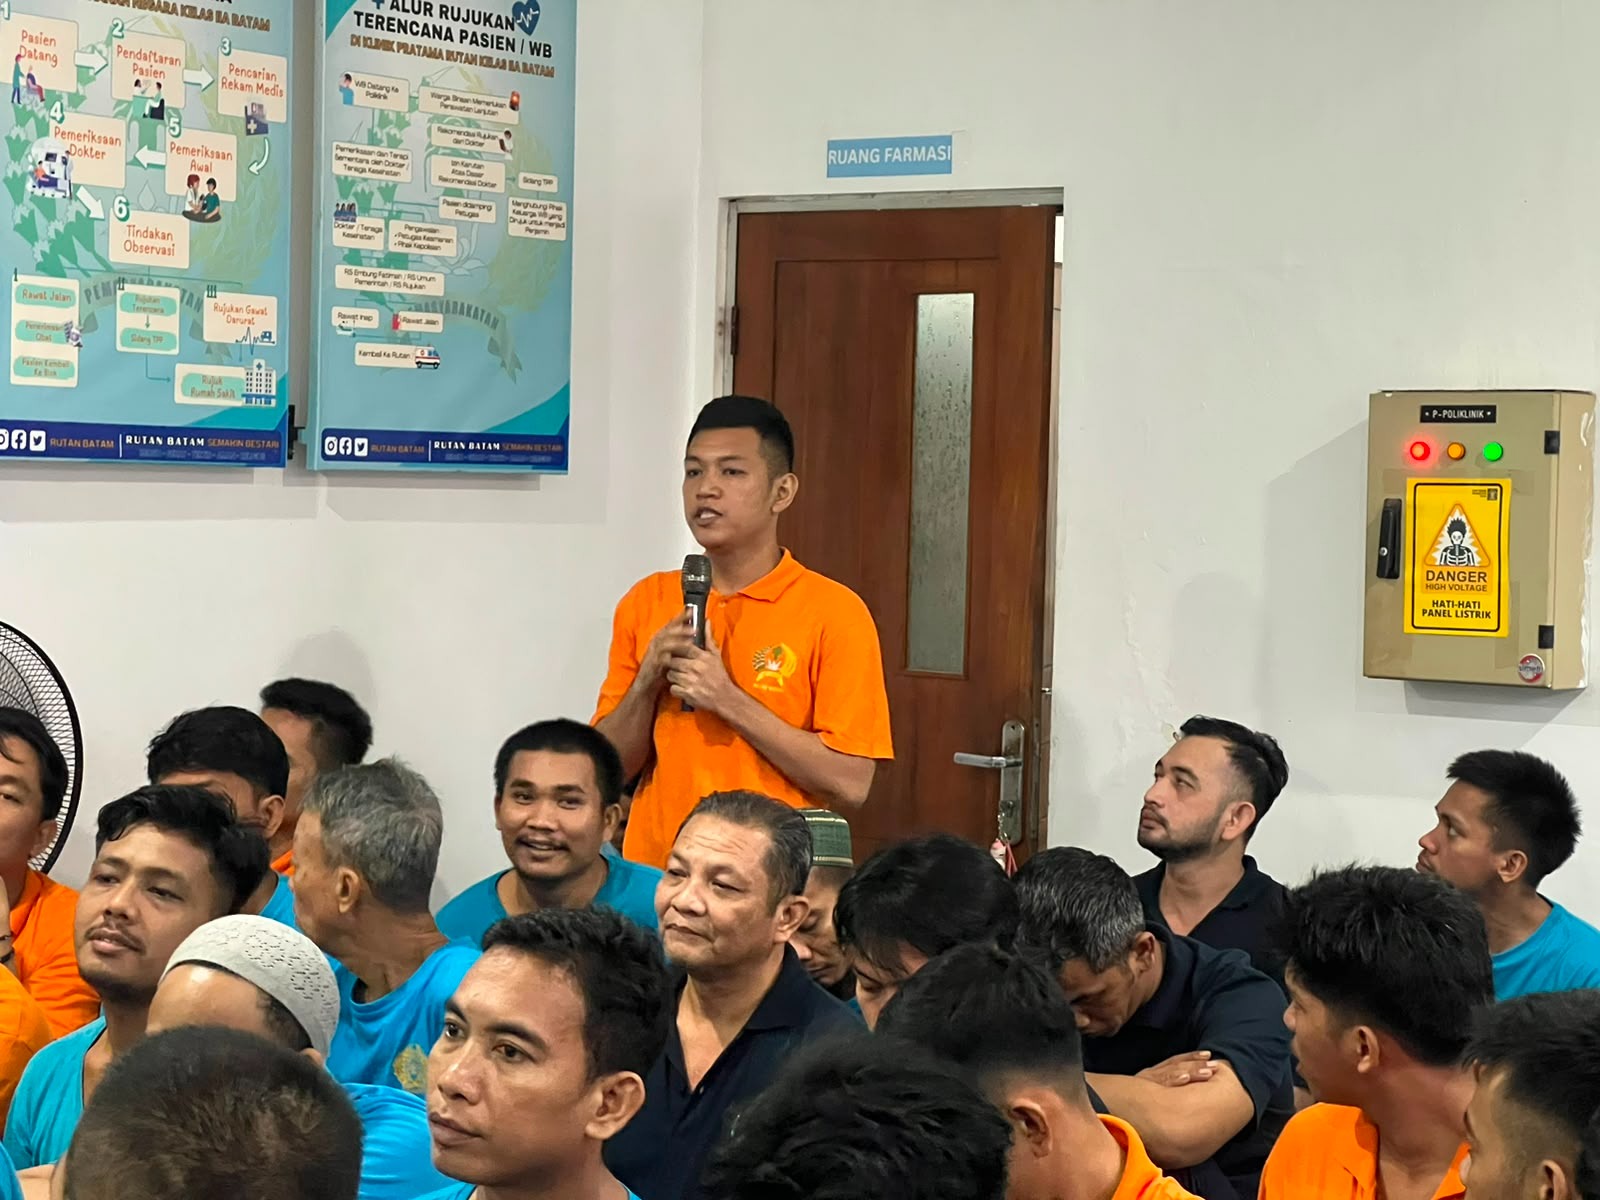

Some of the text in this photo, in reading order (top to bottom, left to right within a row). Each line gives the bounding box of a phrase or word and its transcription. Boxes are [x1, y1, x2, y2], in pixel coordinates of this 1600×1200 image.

[1, 1, 10, 20] 1
[180, 5, 213, 22] KELAS
[231, 14, 270, 32] BATAM
[390, 0, 515, 31] ALUR RUJUKAN
[111, 18, 124, 38] 2
[353, 10, 454, 42] TERENCANA
[459, 29, 515, 52] PASIEN
[529, 41, 552, 58] WB
[21, 29, 56, 47] Pasien
[221, 38, 231, 55] 3
[19, 45, 58, 68] Datang
[116, 44, 181, 67] Pendaftaran
[350, 34, 361, 47] DI
[363, 36, 395, 53] KLINIK
[396, 41, 444, 60] PRATAMA
[446, 49, 478, 66] RUTAN
[479, 55, 507, 70] KELAS
[521, 62, 555, 78] BATAM
[132, 62, 166, 80] Pasien
[228, 63, 277, 83] Pencarian
[221, 76, 284, 98] Rekam Medis
[50, 101, 64, 122] 4
[169, 117, 181, 137] 5
[54, 126, 122, 147] Pemeriksaan
[69, 144, 106, 160] Dokter
[169, 141, 233, 161] Pemeriksaan
[828, 145, 951, 165] RUANG FARMASI
[190, 159, 213, 173] Awal
[114, 196, 129, 220] 6
[126, 224, 173, 242] Tindakan
[123, 240, 176, 257] Observasi
[22, 288, 71, 302] Rawat Jalan
[213, 302, 268, 316] Rujukan Gawat
[226, 314, 255, 326] Darurat
[190, 387, 215, 398] Rumah
[1432, 409, 1484, 419] P-POLIKLINIK
[50, 437, 115, 449] RUTAN BATAM
[125, 435, 164, 446] RUTAN
[166, 436, 205, 447] BATAM
[207, 437, 244, 448] SEMAKIN
[371, 444, 425, 453] RUTAN BATAM
[434, 440, 465, 450] RUTAN
[468, 441, 500, 450] BATAM
[1425, 570, 1487, 583] DANGER
[1425, 583, 1487, 592] HIGH VOLTAGE
[1422, 608, 1491, 619] PANEL LISTRIK
[1432, 600, 1480, 609] HATI-HATI
